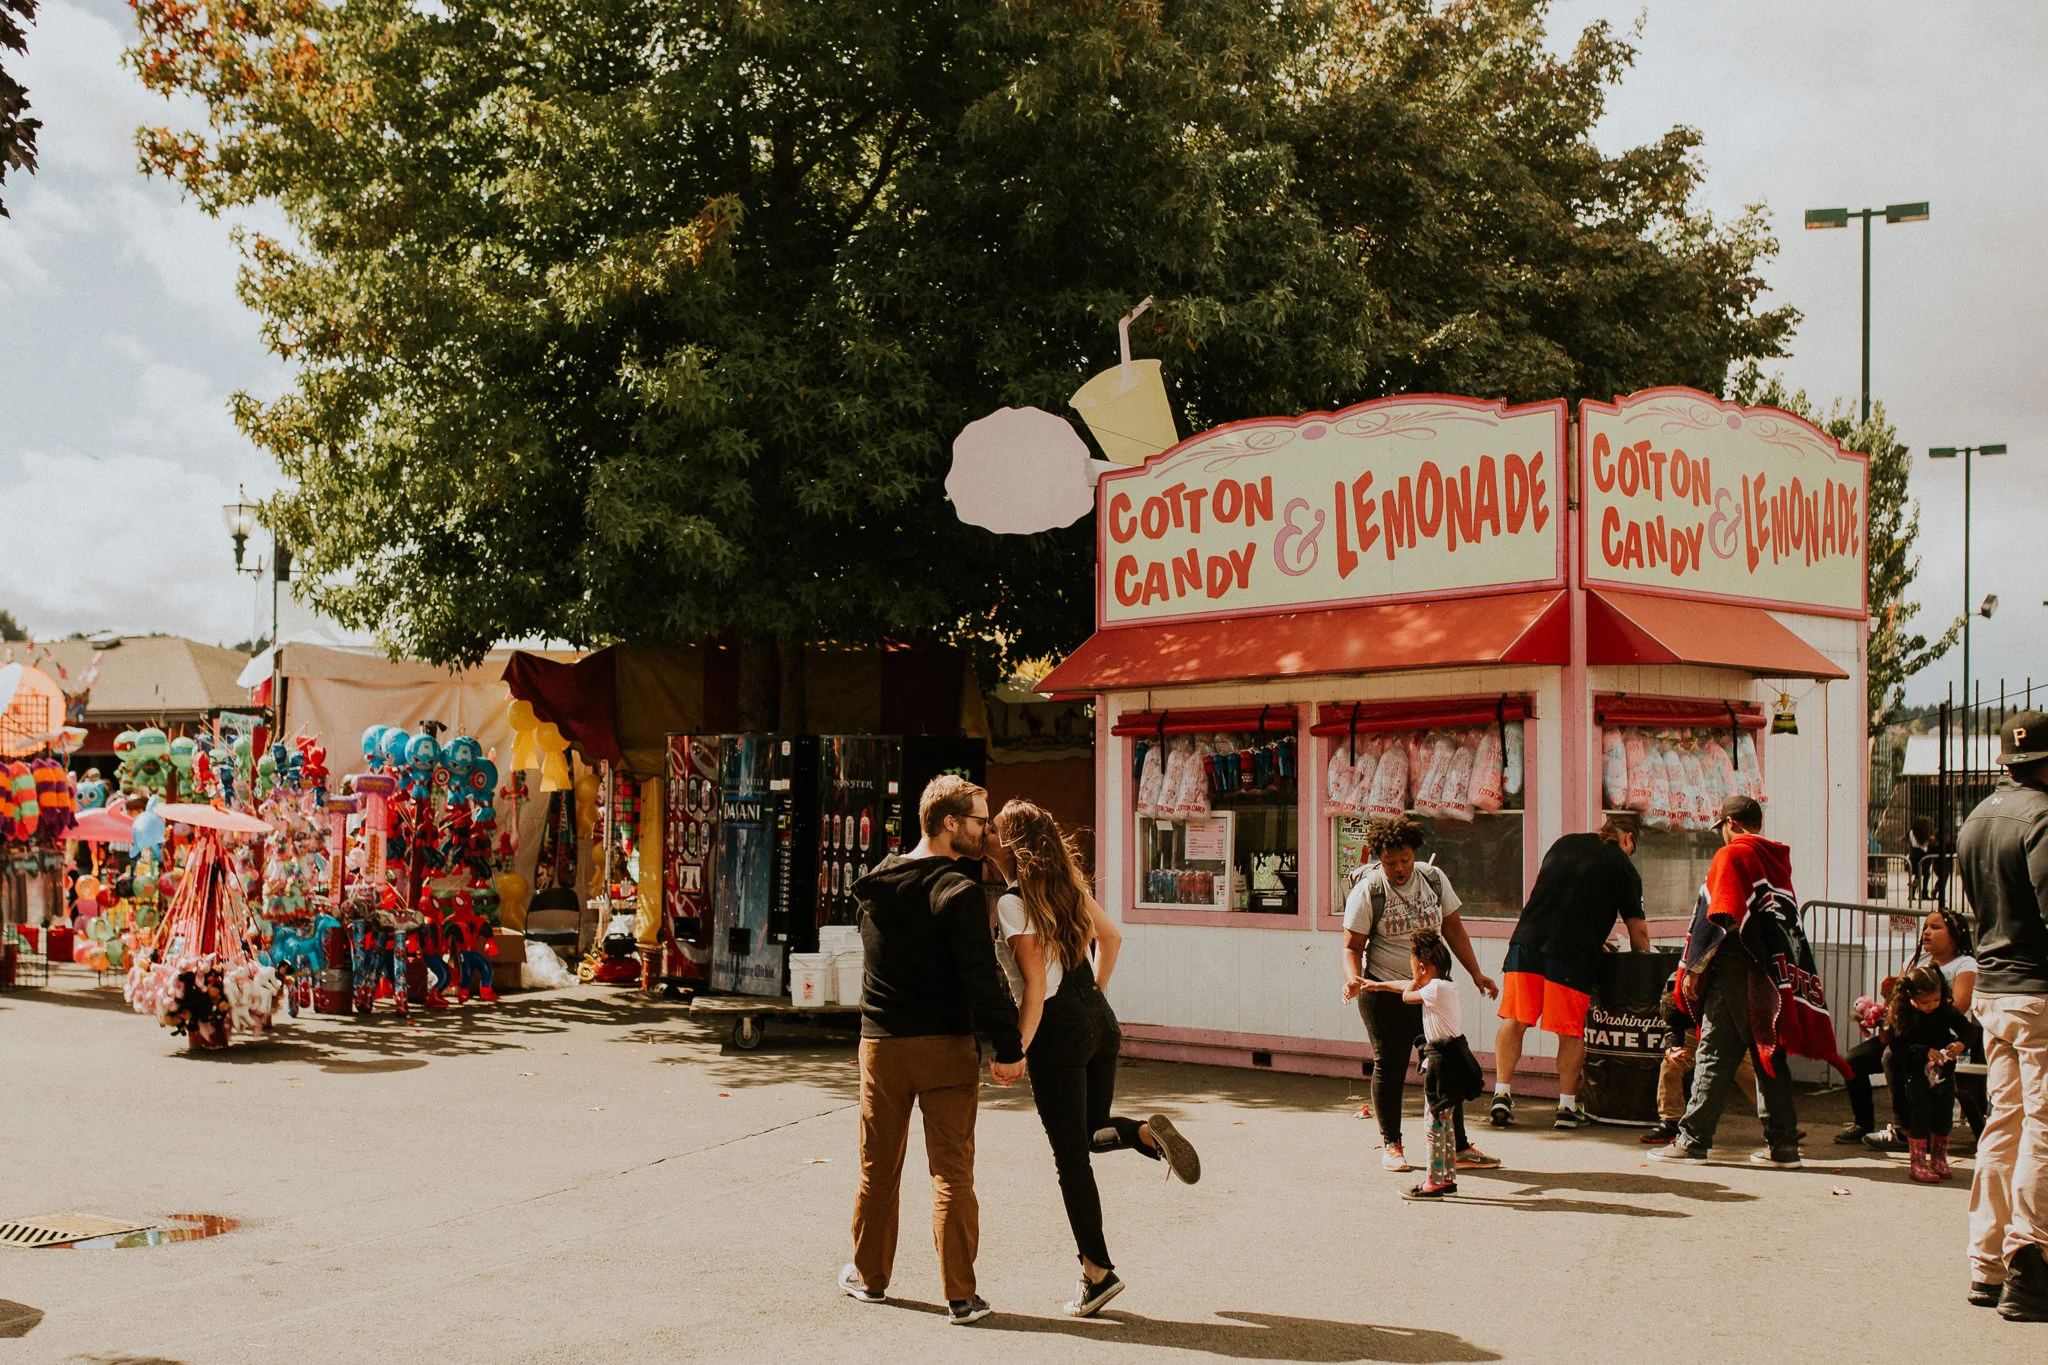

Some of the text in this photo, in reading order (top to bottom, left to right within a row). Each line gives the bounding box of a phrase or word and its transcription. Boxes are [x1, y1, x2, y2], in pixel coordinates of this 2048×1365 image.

[1592, 432, 1711, 507] COTTON
[1109, 476, 1274, 543] COTTON
[1274, 450, 1550, 580] & LEMONADE
[1601, 506, 1704, 576] CANDY
[1708, 472, 1859, 574] & LEMONADE
[1114, 542, 1257, 607] CANDY
[2012, 727, 2027, 747] P
[723, 802, 761, 821] DASANI
[833, 779, 874, 790] MONSTER
[1592, 1009, 1667, 1033] Washingto
